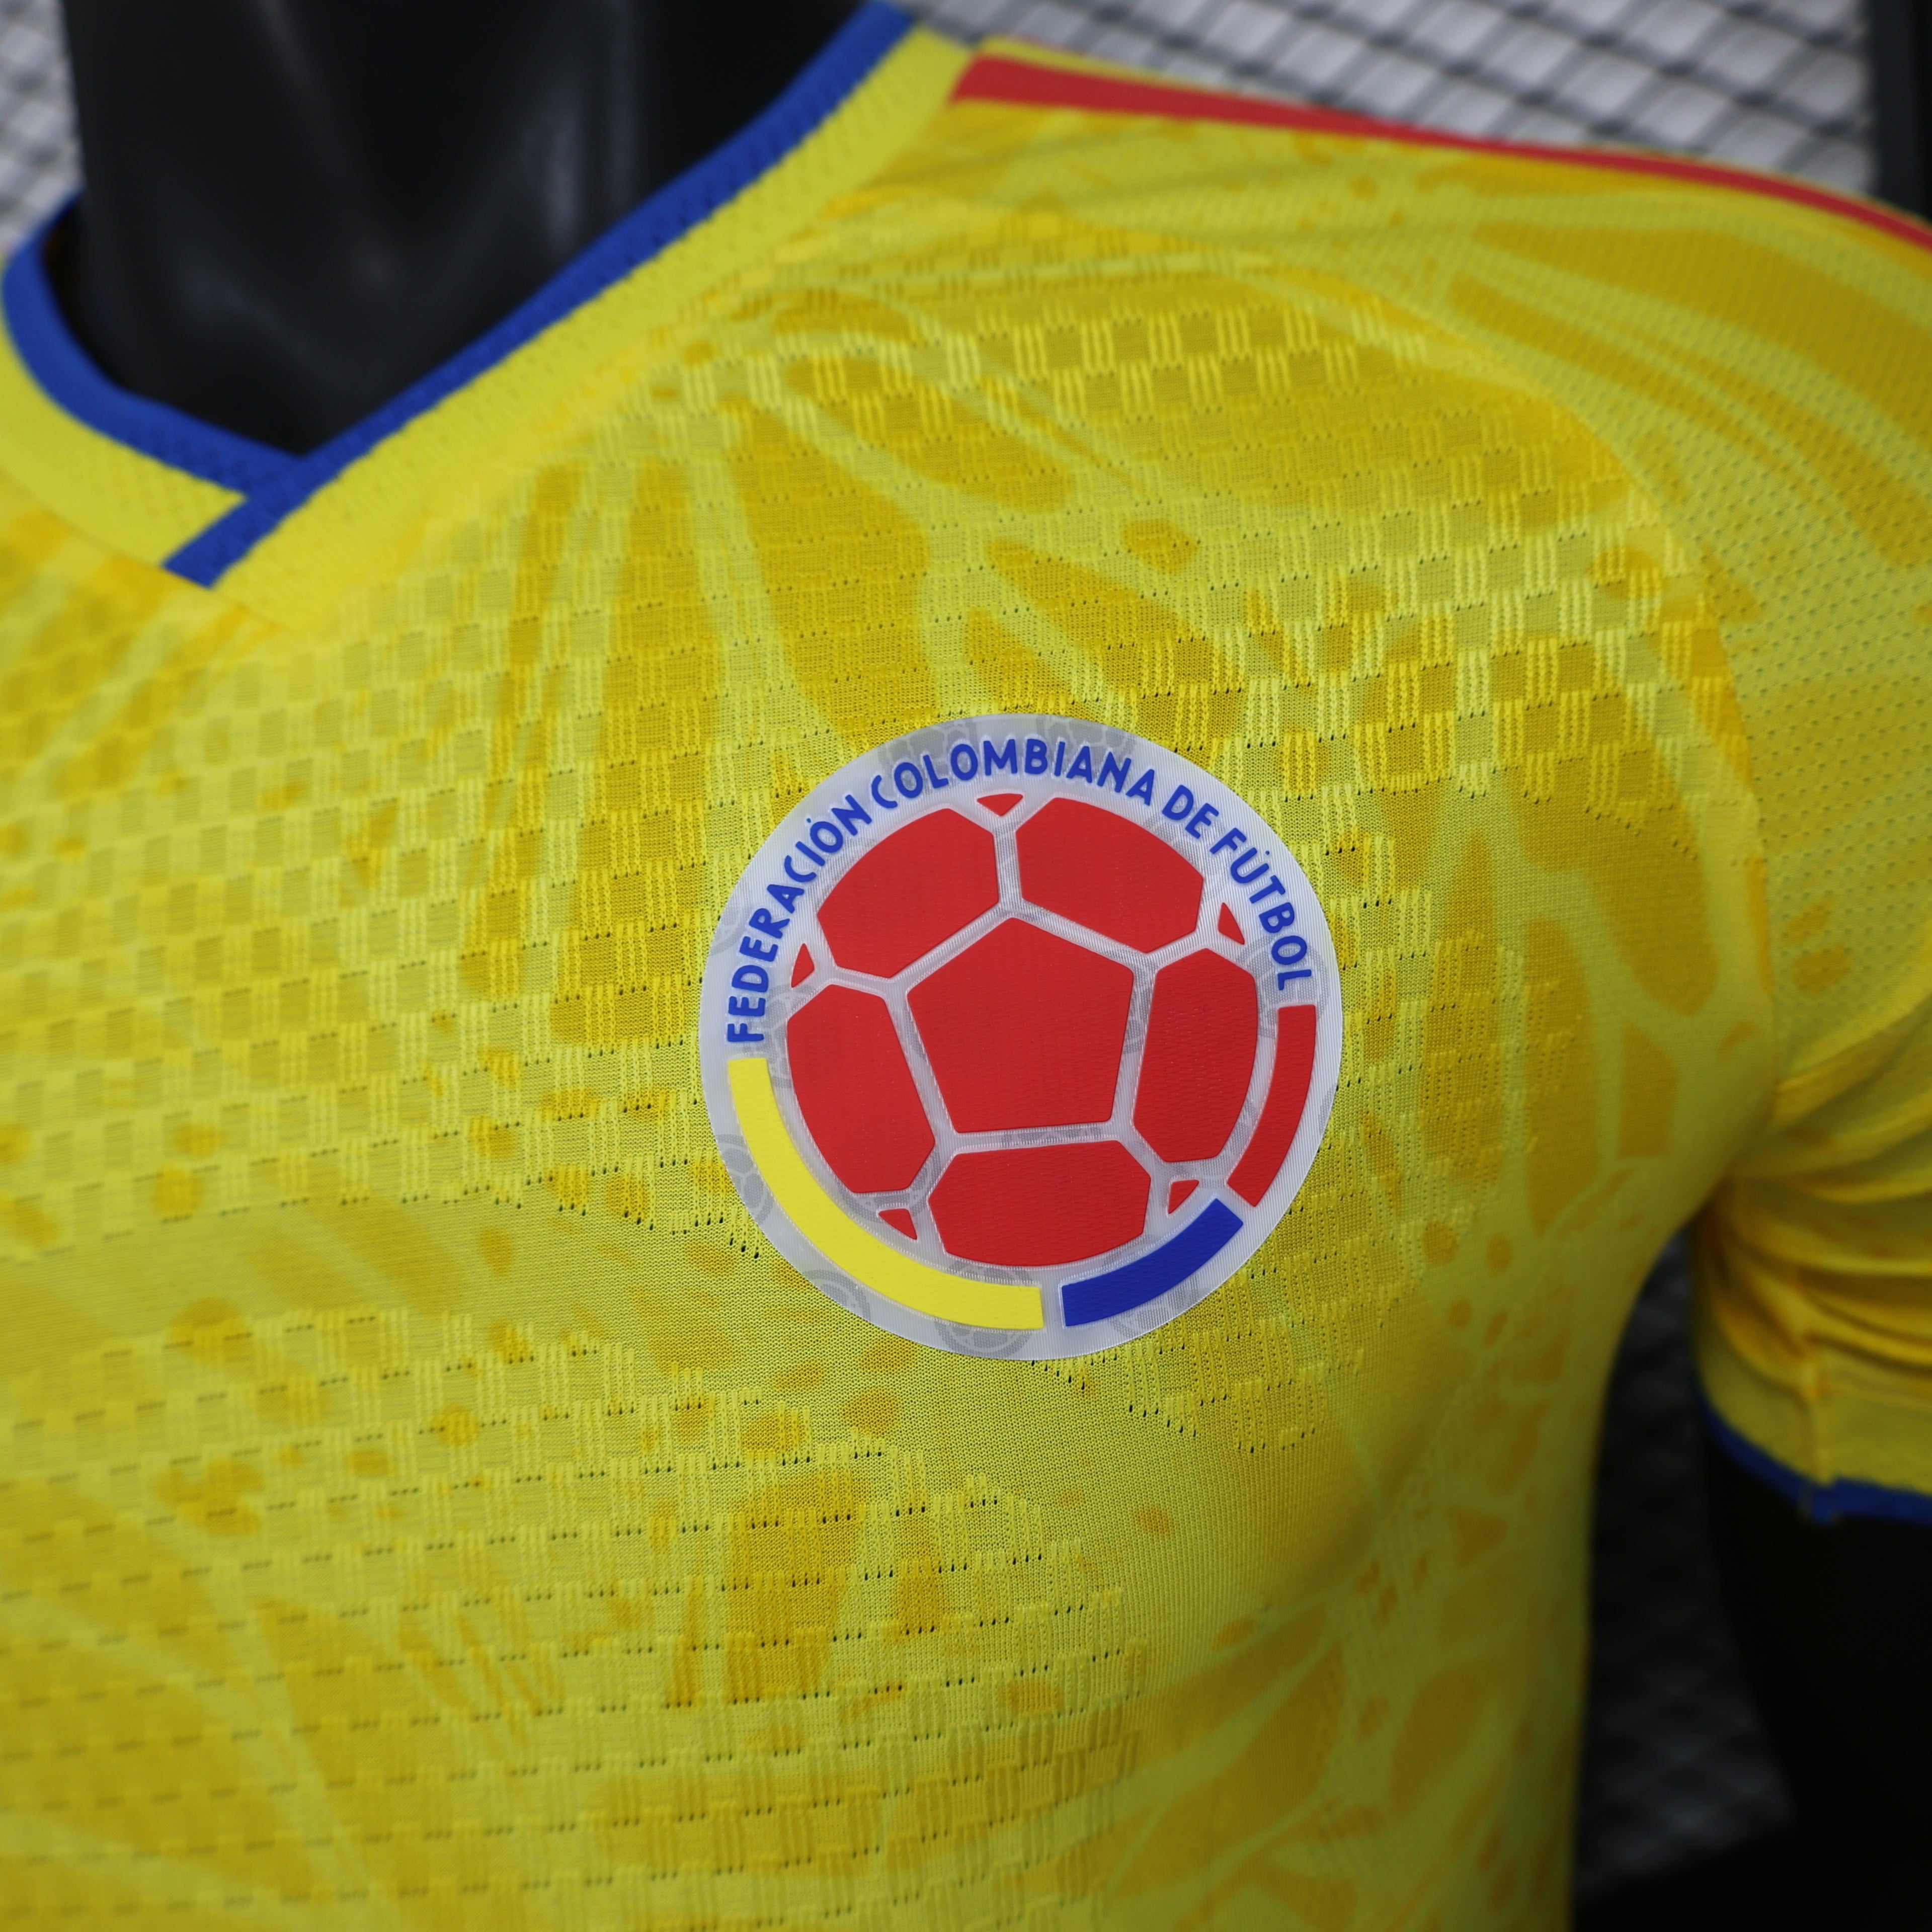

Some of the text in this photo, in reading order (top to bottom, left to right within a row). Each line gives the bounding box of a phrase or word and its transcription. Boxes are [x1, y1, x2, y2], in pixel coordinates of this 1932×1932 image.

[727, 738, 1312, 1042] FEDERACIÓN COLOMBIANA DE FÚTBOL
